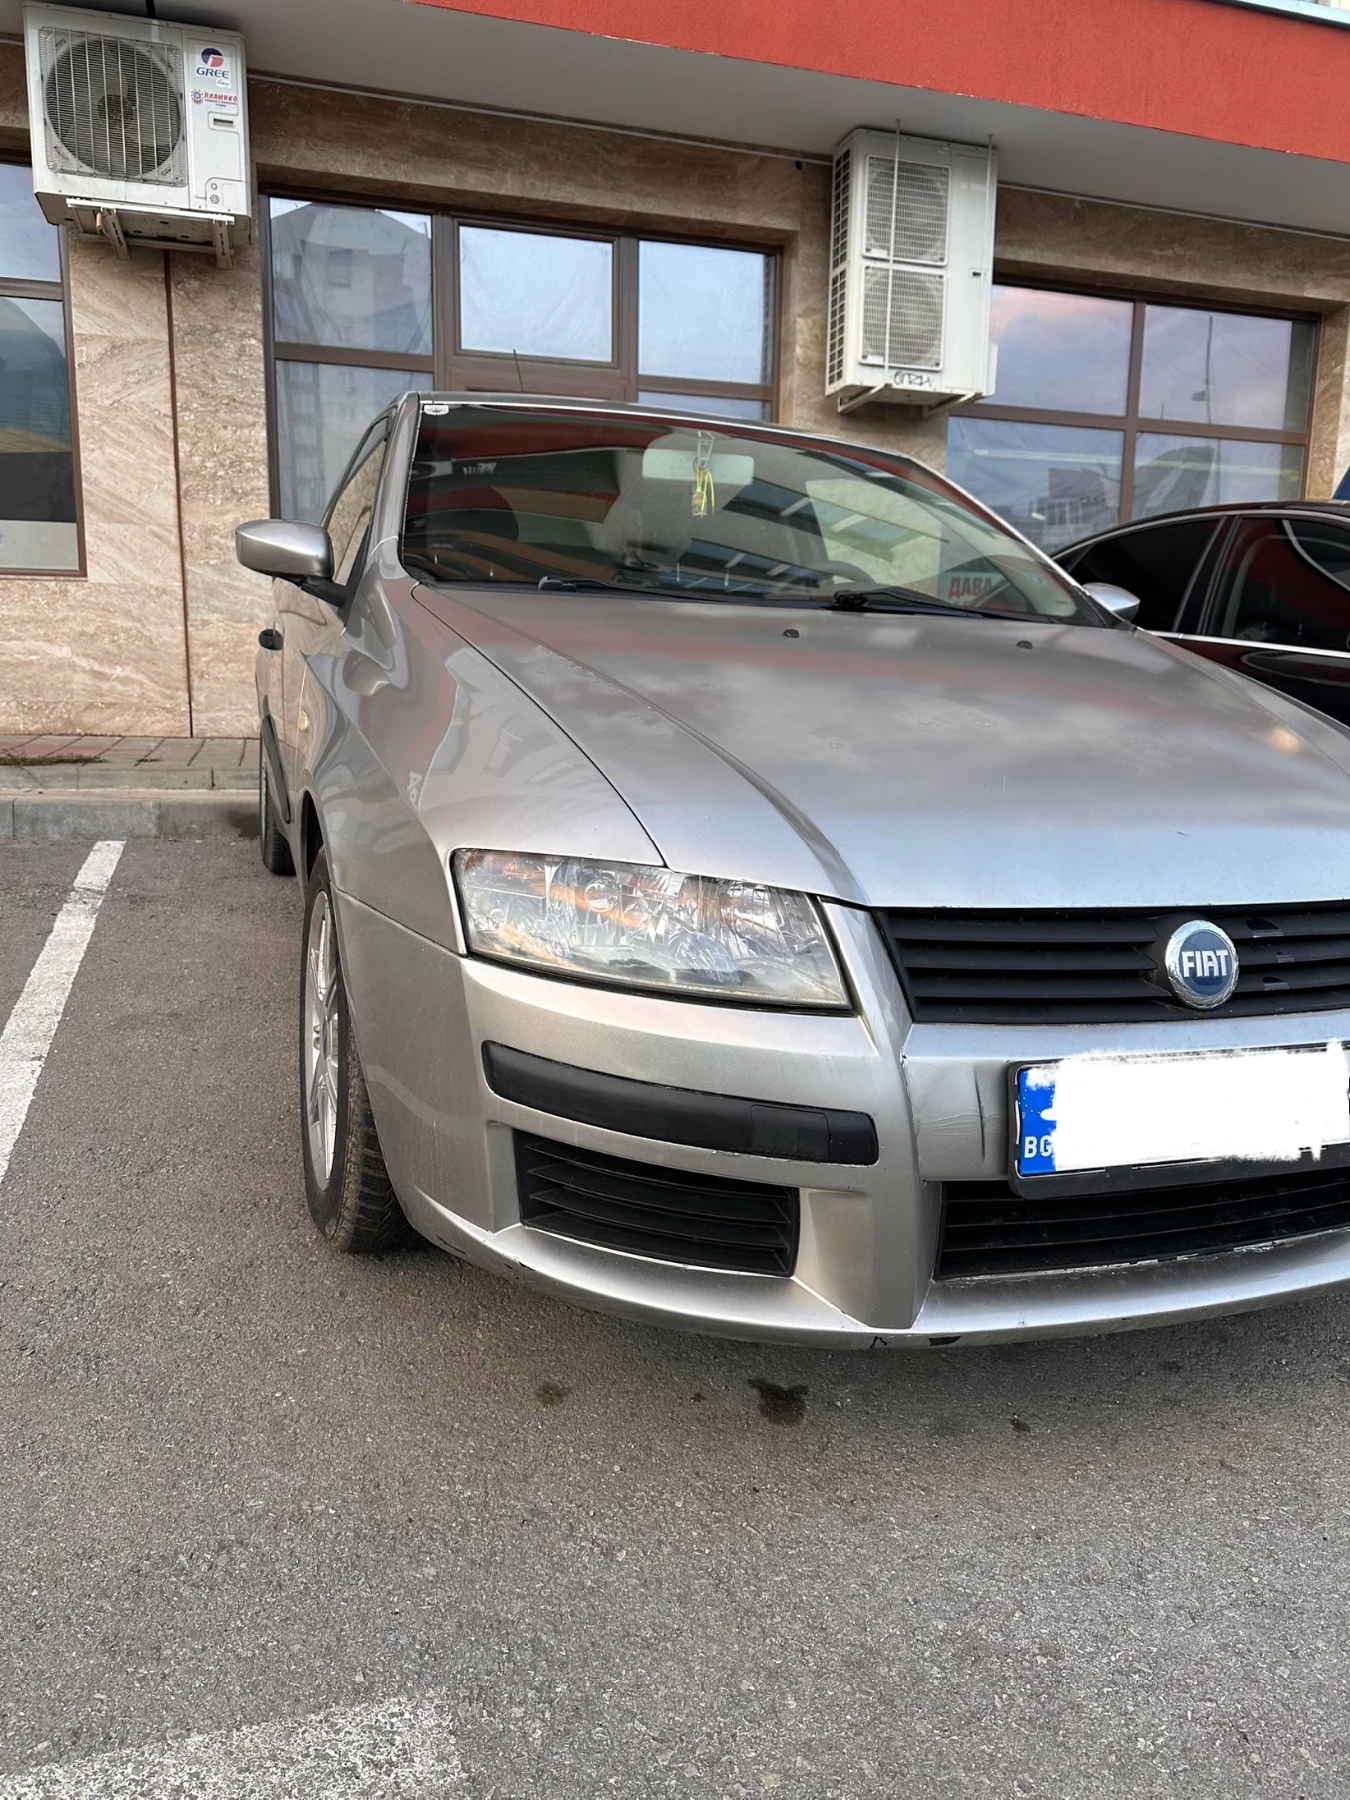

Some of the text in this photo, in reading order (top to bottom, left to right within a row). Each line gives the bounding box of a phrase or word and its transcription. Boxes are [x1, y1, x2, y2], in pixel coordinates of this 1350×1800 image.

[196, 67, 230, 79] GREE
[1182, 949, 1229, 978] FIAT
[1024, 1135, 1053, 1158] BG
